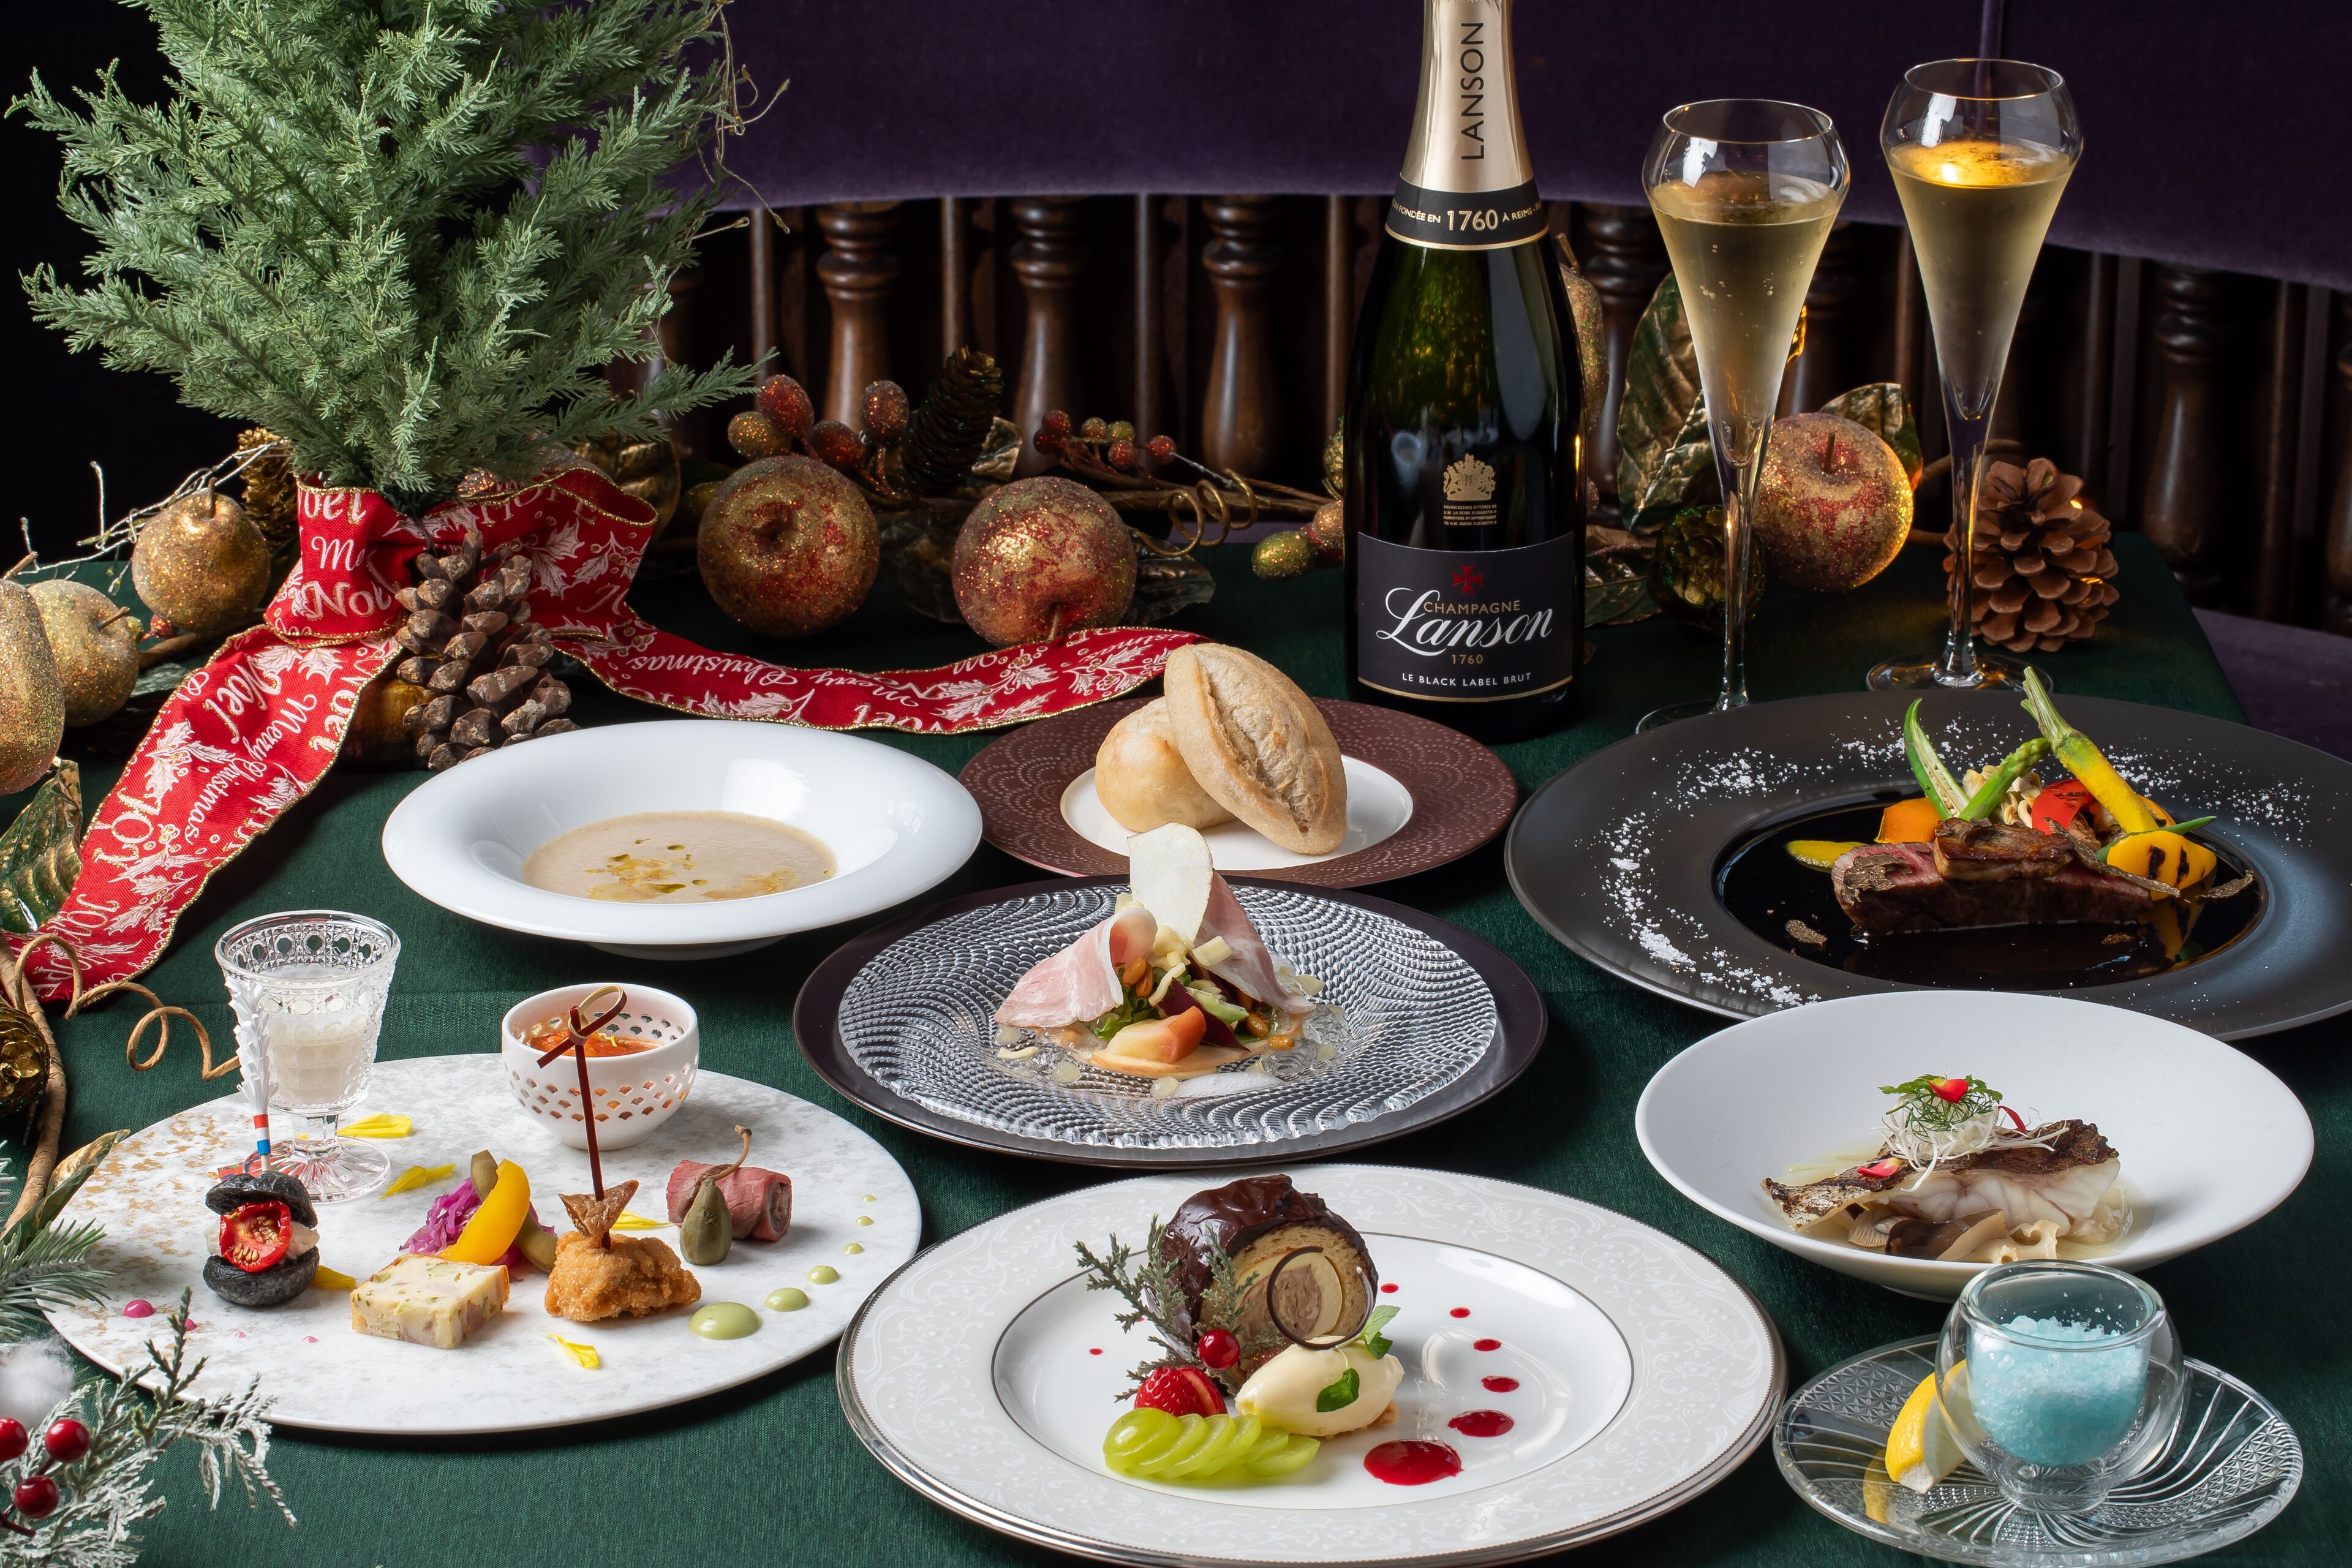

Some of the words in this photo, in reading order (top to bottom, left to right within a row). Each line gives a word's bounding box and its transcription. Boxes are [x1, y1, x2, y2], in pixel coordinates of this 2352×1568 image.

[1460, 22, 1485, 160] LANSON
[1398, 205, 1426, 221] FONDÉE
[1427, 213, 1441, 224] EN
[1447, 209, 1499, 231] 1760
[1511, 207, 1532, 221] REIMS
[296, 491, 366, 525] oel
[1376, 587, 1553, 657] Lanson
[1423, 600, 1521, 614] CHAMPAGNE
[625, 654, 798, 685] Christmas
[1452, 654, 1483, 665] 1760
[809, 671, 919, 707] Merry
[1402, 673, 1413, 682] LE
[1419, 676, 1457, 687] BLACK
[1463, 678, 1498, 687] LABEL
[1504, 673, 1531, 684] BRUT
[202, 655, 282, 744] Noel
[243, 693, 317, 761] Merry
[184, 757, 267, 845] Christmas
[91, 787, 162, 869] JOY
